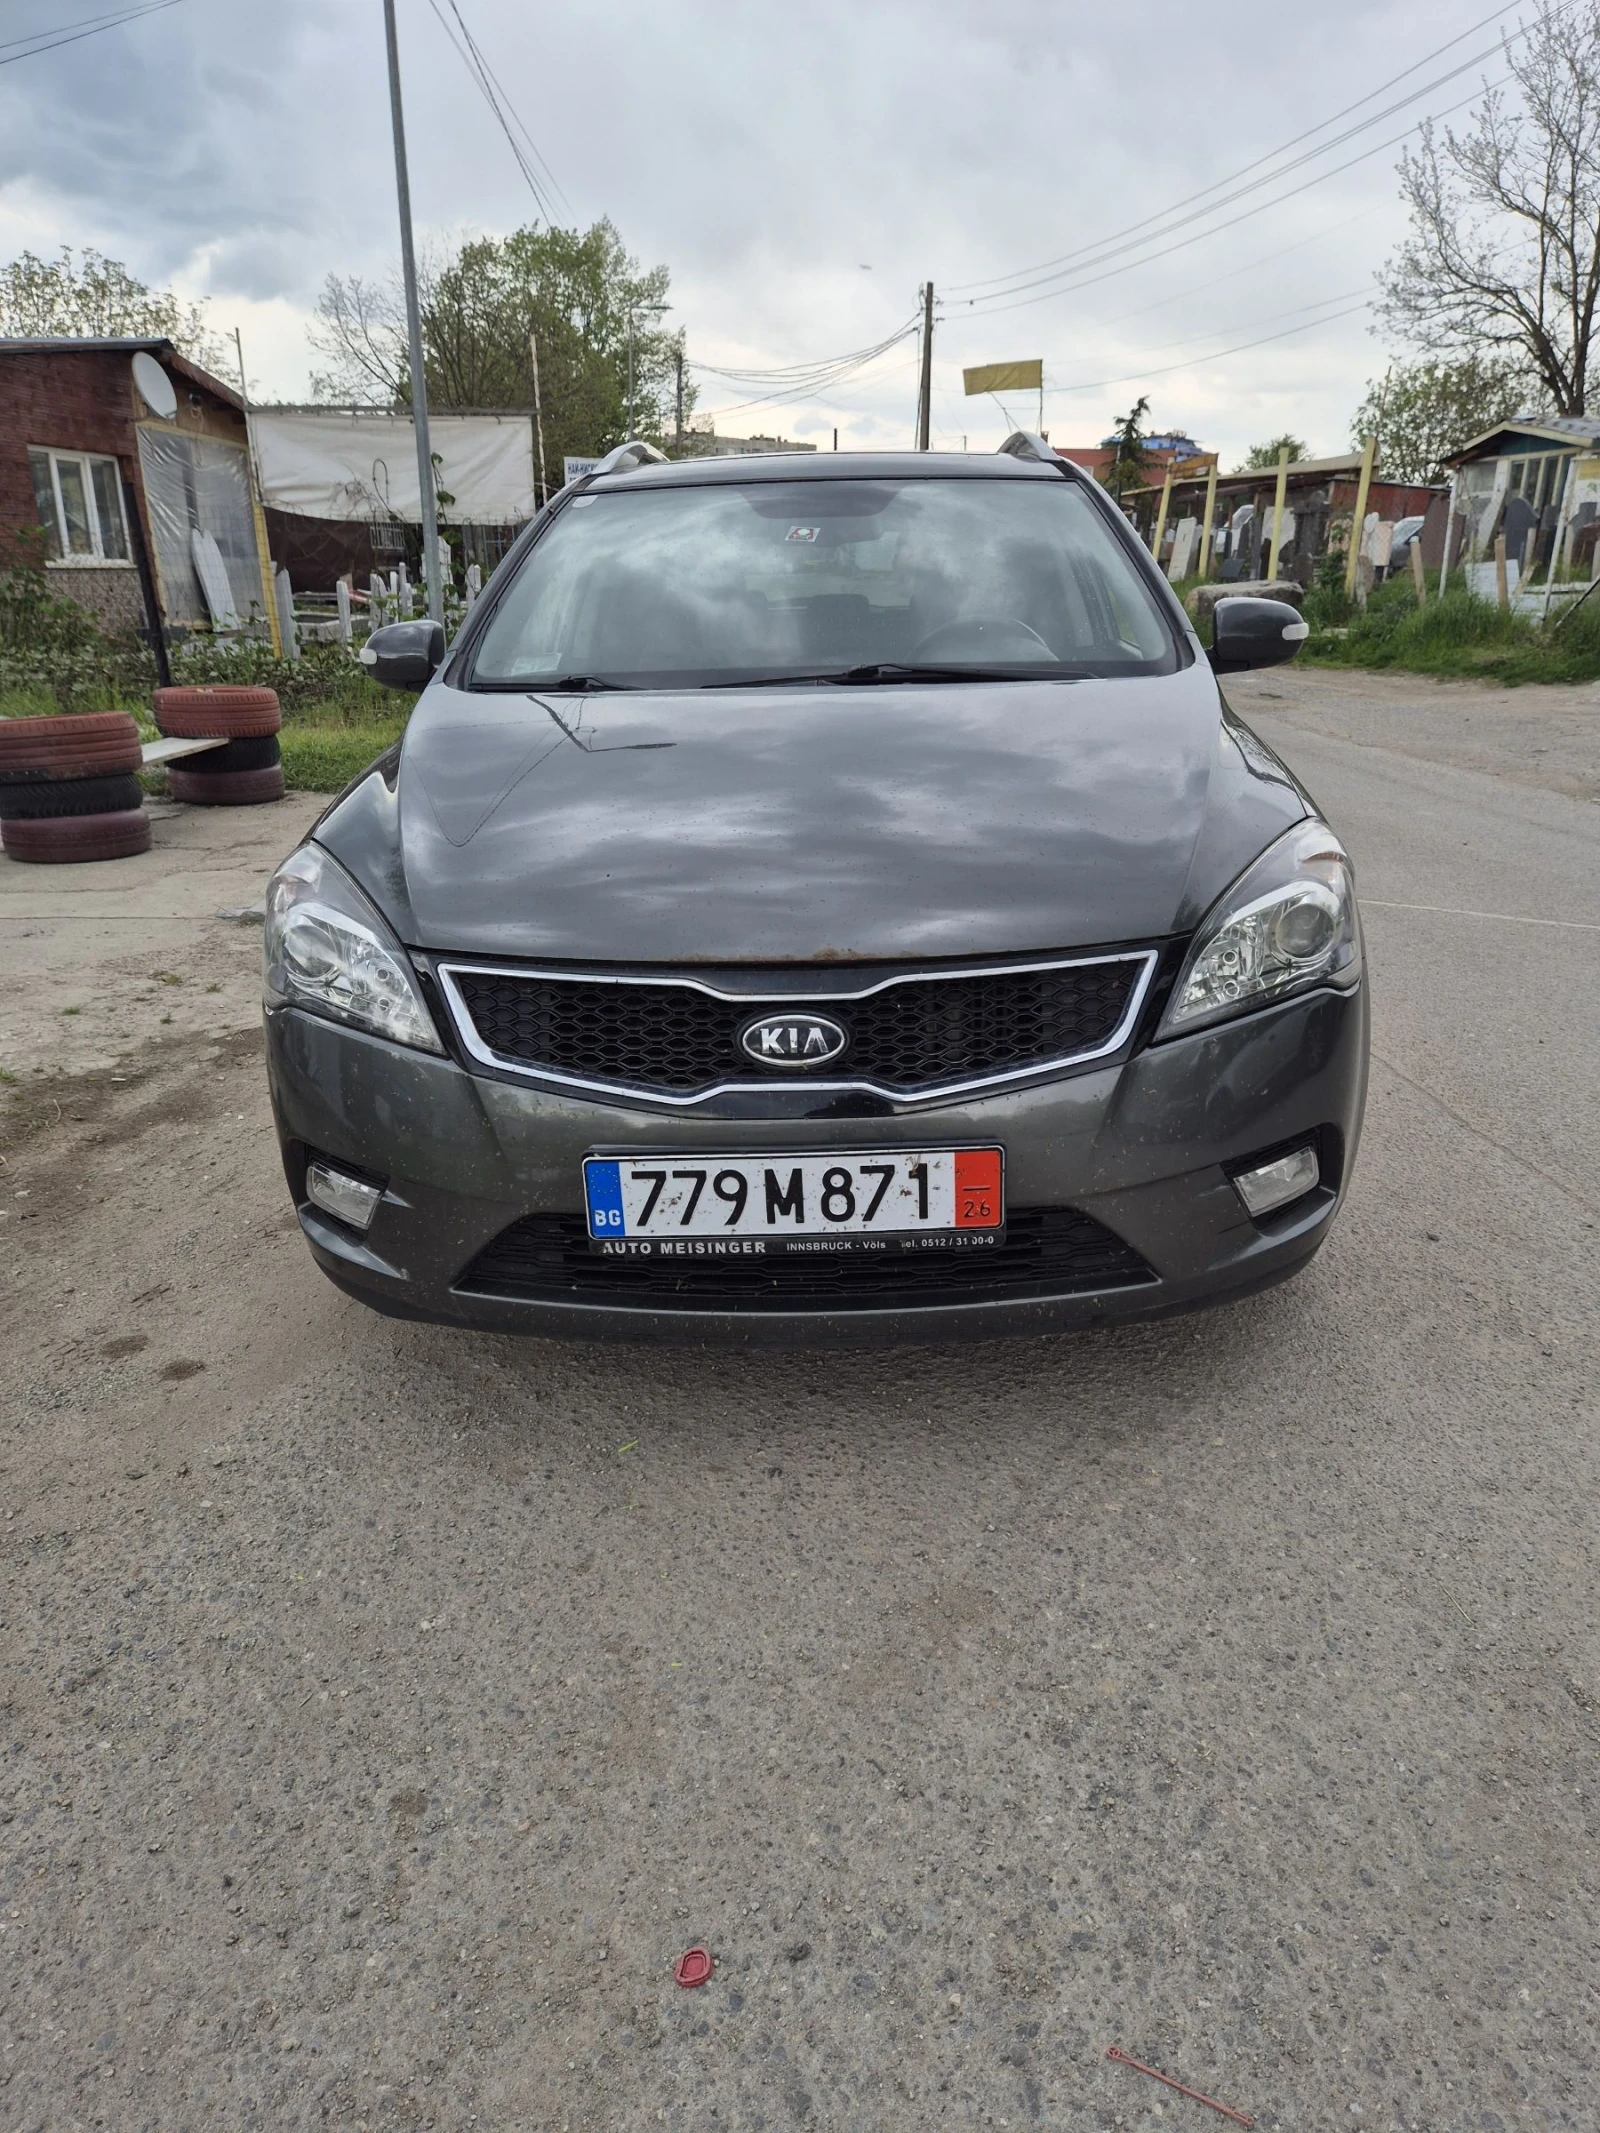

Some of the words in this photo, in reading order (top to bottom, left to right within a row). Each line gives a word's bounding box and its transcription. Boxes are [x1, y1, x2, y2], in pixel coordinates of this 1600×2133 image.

[760, 1027, 829, 1054] KIA
[630, 1169, 749, 1227] 779
[764, 1168, 805, 1225] M
[820, 1163, 929, 1222] 871
[964, 1199, 991, 1218] 26
[595, 1209, 621, 1227] BG
[602, 1242, 652, 1255] AUTO
[660, 1241, 767, 1255] MEISINGER
[786, 1241, 852, 1251] INNSBRUCK
[863, 1239, 886, 1250] Völs
[921, 1238, 946, 1247] 0512
[956, 1237, 968, 1246] 31
